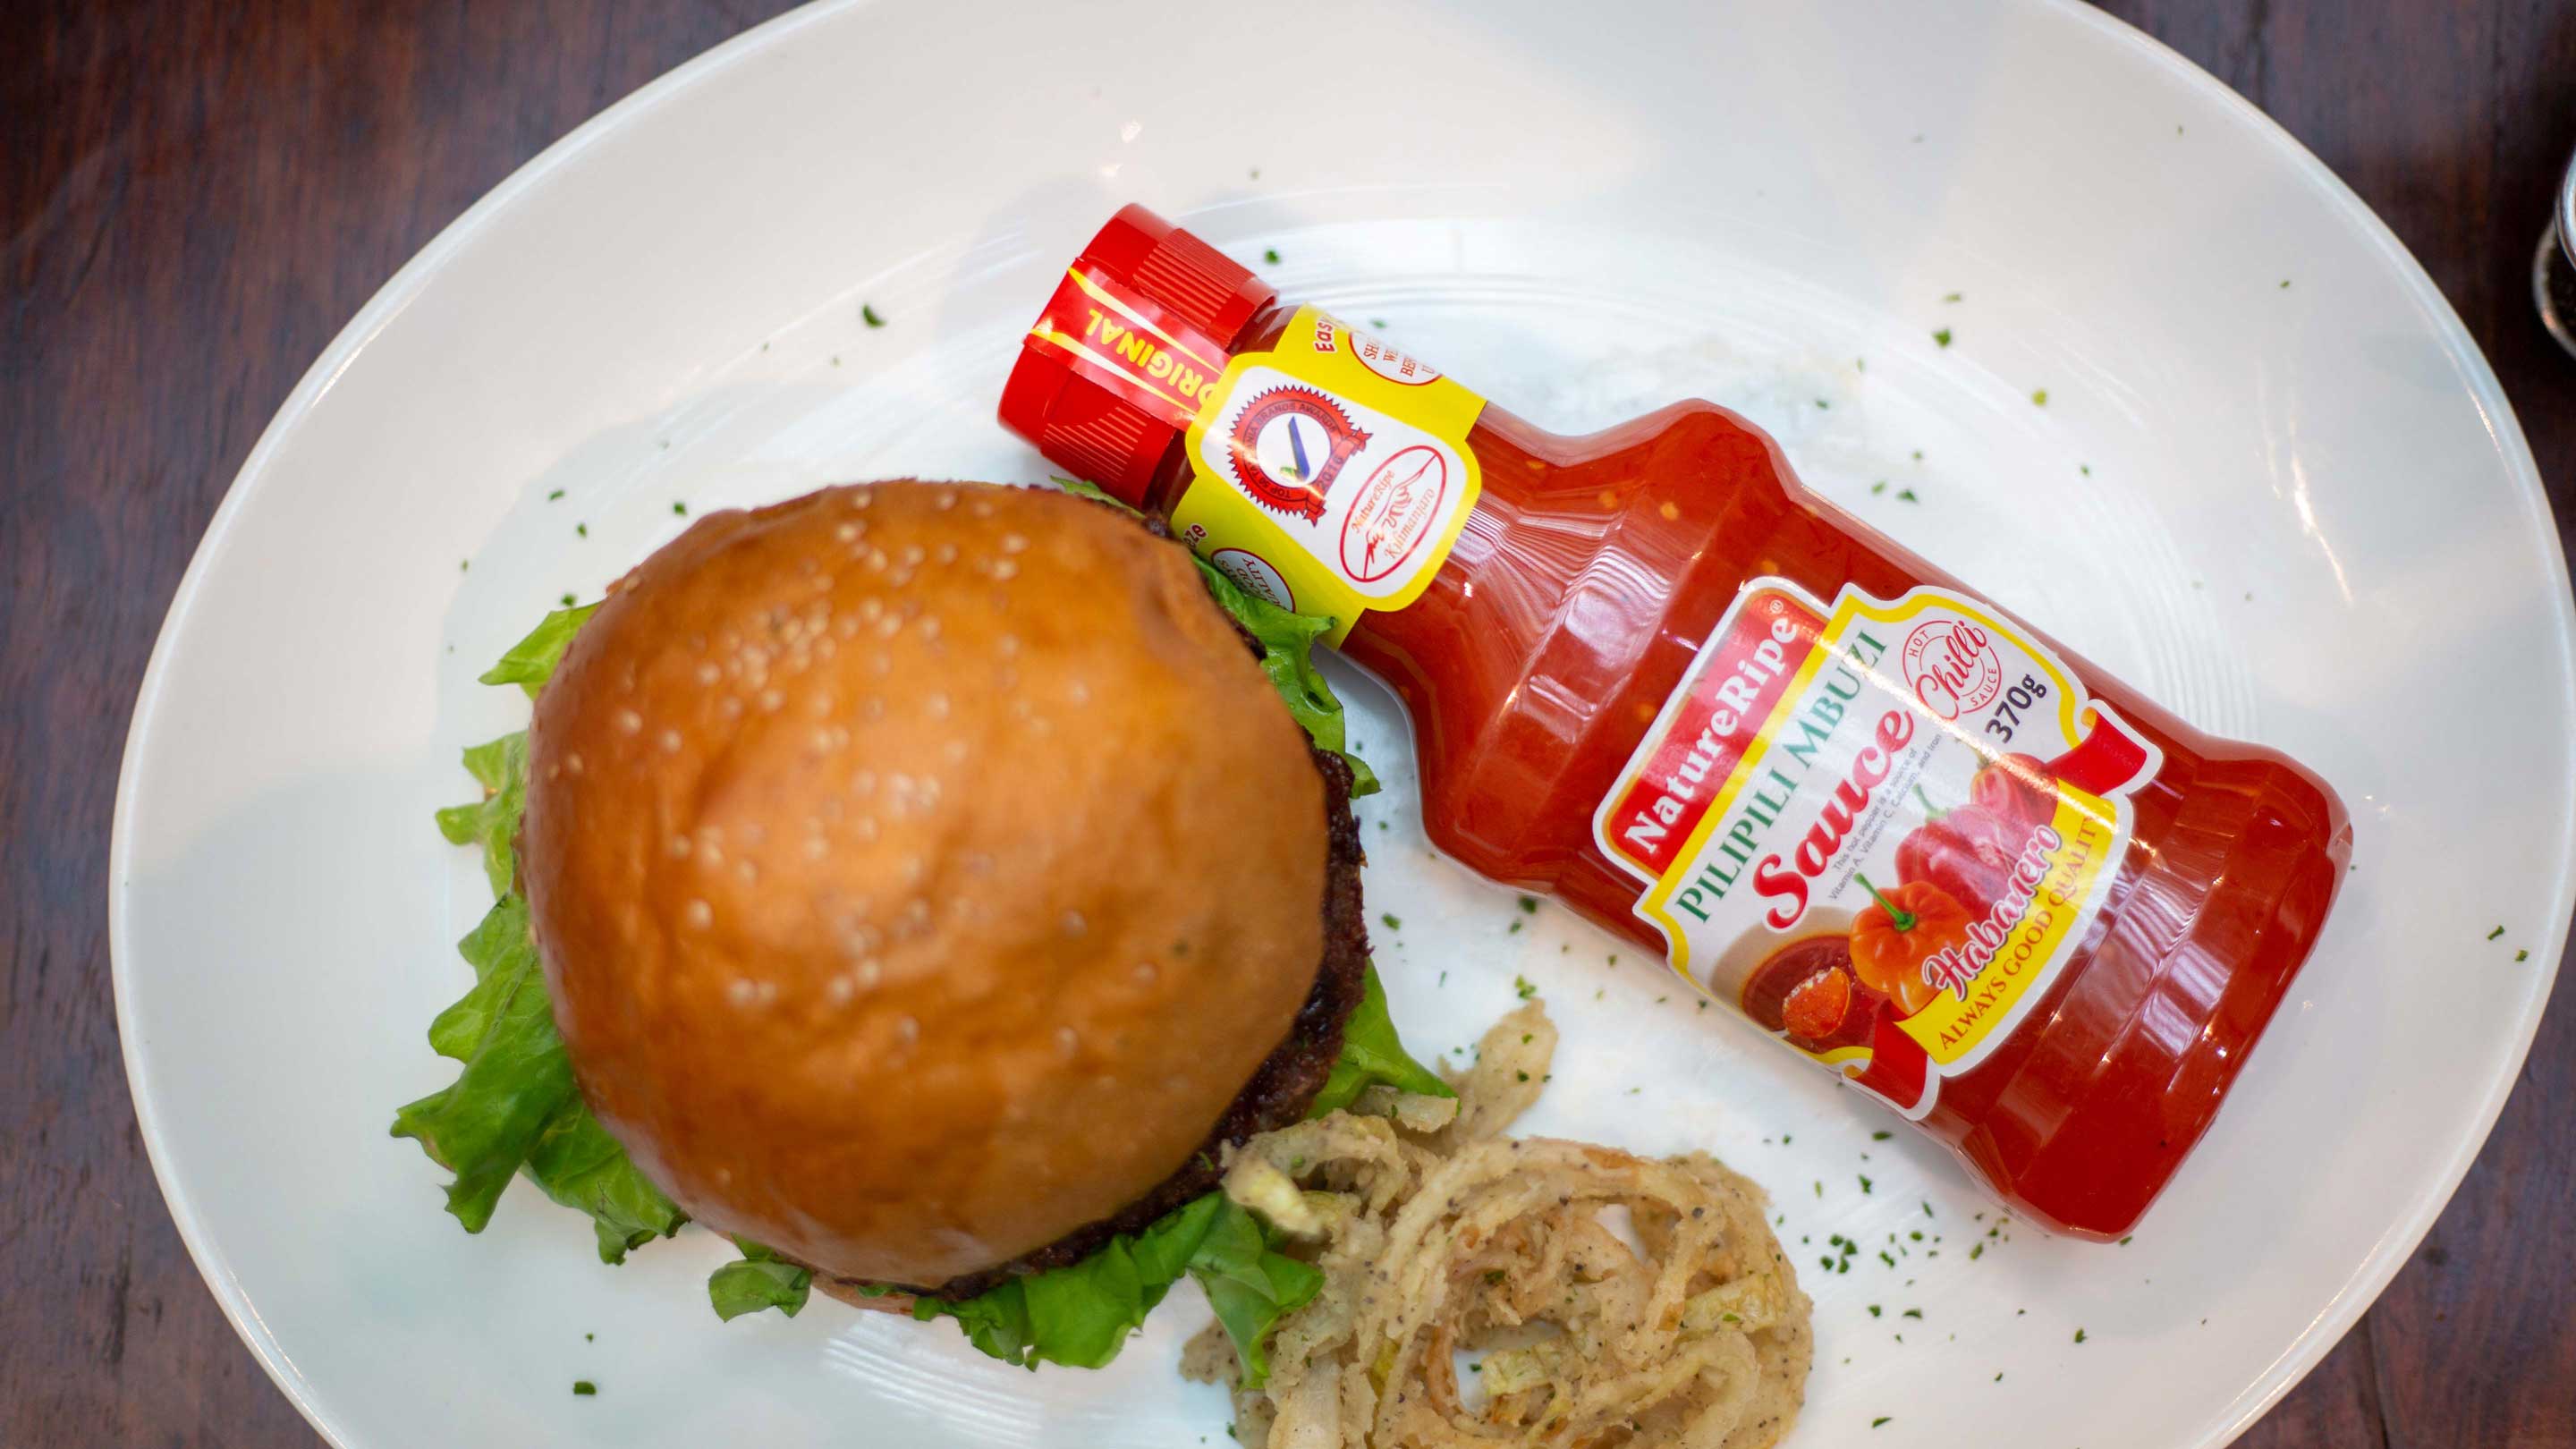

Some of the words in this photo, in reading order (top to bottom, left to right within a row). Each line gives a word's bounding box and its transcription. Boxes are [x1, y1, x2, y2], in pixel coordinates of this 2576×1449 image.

[1257, 402, 1296, 425] BRANDS
[1271, 487, 1290, 498] TOP
[1317, 456, 1343, 490] 2016
[1385, 487, 1435, 559] Kilimanjaro
[1242, 557, 1281, 606] UALITY
[1909, 630, 1929, 657] HOT
[1916, 620, 1987, 722] Chilli
[1970, 668, 1996, 707] SAUCE
[1985, 674, 2046, 743] 370g
[1676, 767, 1798, 923] PILIPILI
[1782, 630, 1887, 770] MBUZI
[1753, 710, 1913, 929] Sauce
[1828, 867, 1855, 900] Vitamin
[1860, 819, 1887, 855] Vitamin
[1919, 752, 1931, 768] and
[1833, 851, 1850, 870] This
[1847, 837, 1860, 852] hot
[1860, 805, 1880, 836] pepper
[1923, 825, 2060, 1002] Habanero
[1938, 976, 2008, 1050] ALWAYS
[2003, 910, 2053, 977] GOOD
[2047, 815, 2097, 908] QUALITY
